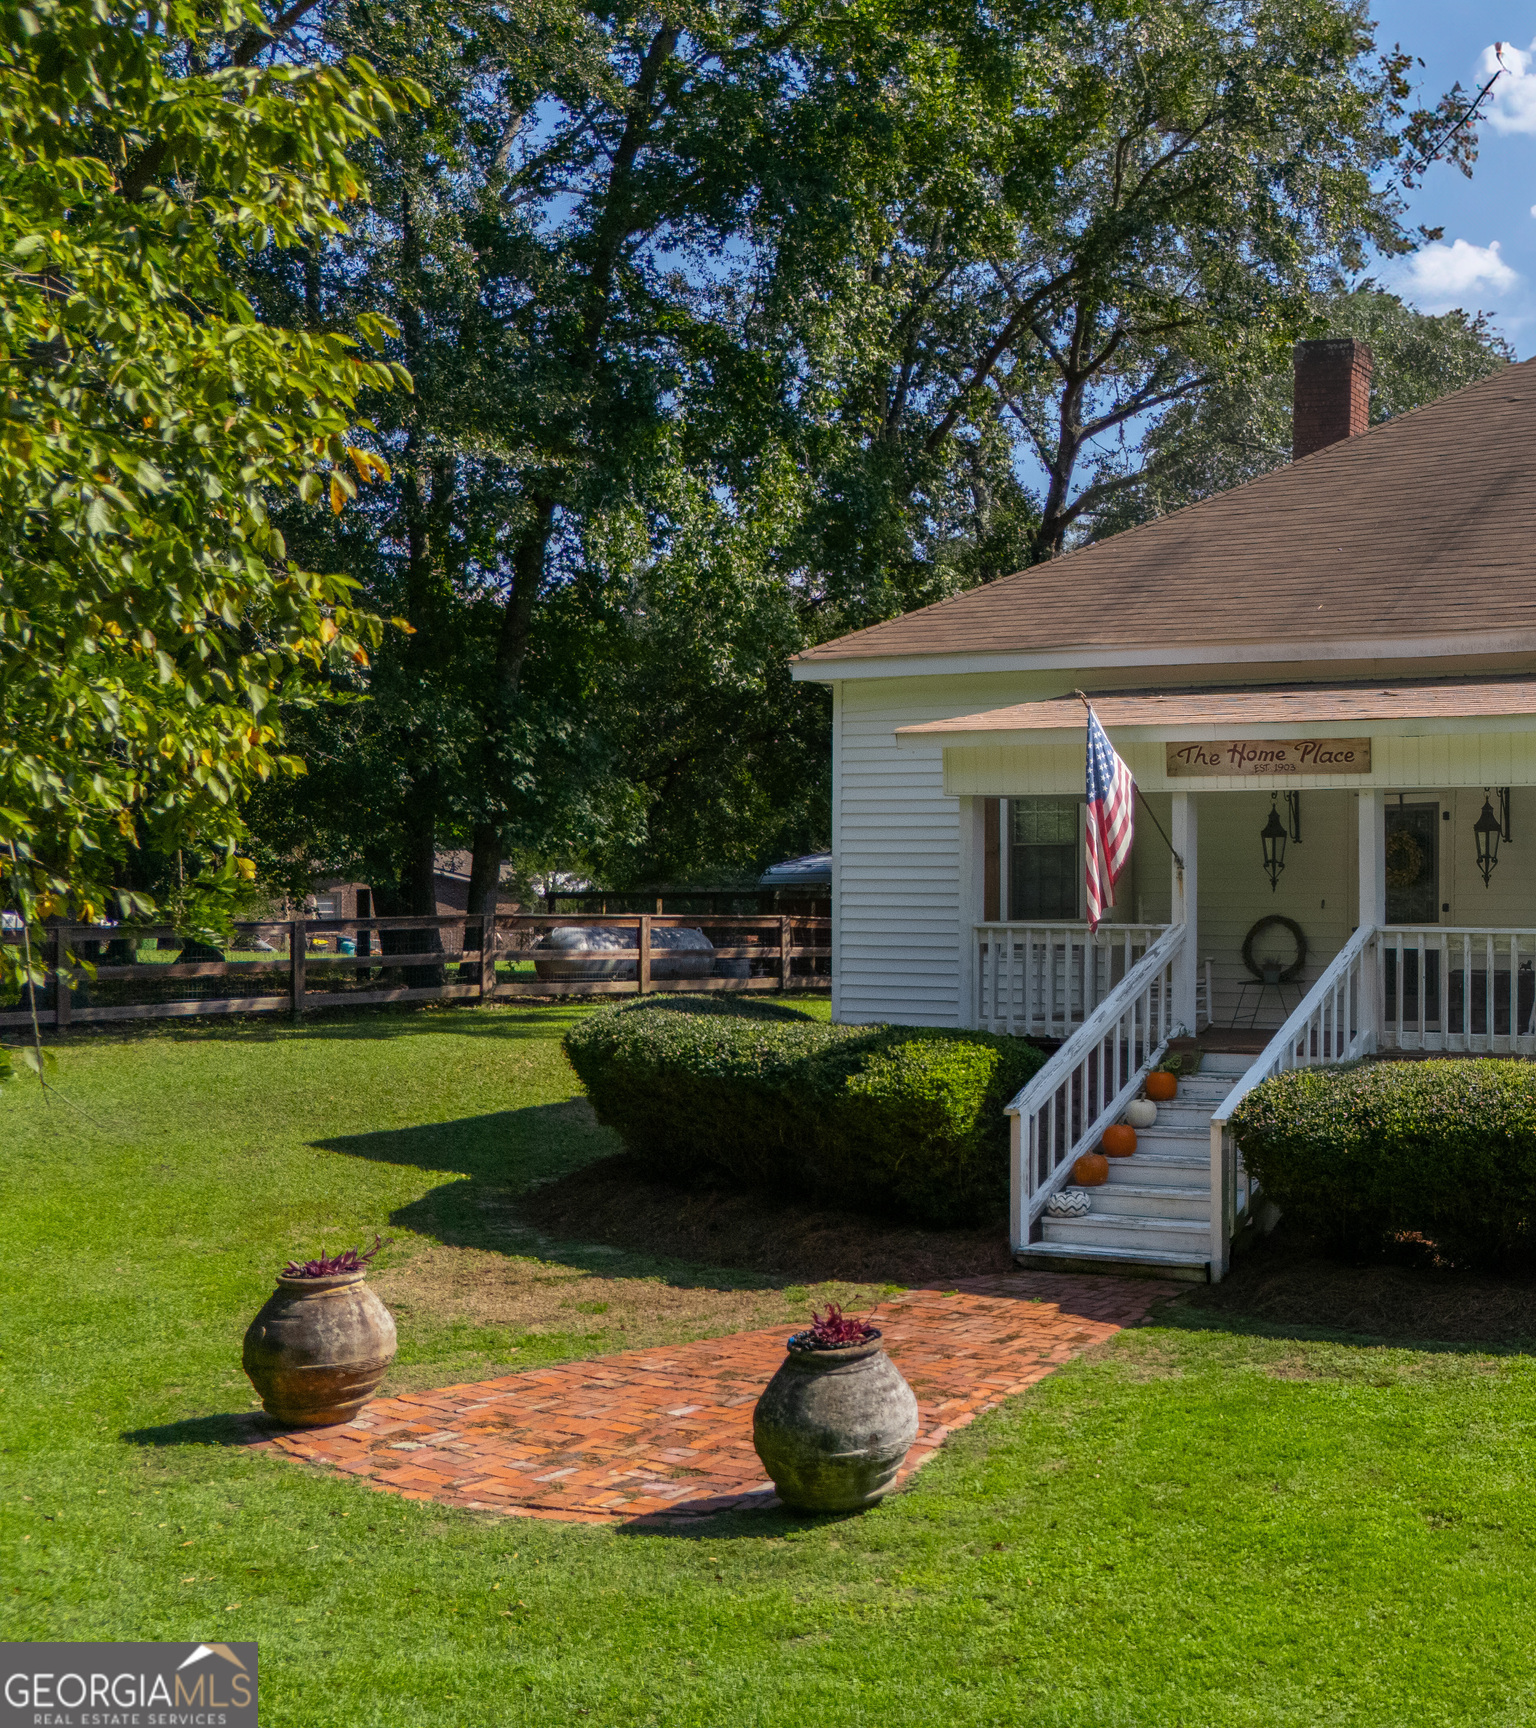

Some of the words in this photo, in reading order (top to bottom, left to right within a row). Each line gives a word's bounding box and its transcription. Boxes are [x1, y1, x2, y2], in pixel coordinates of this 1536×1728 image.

[1177, 745, 1221, 766] The
[1227, 743, 1286, 769] Home
[1294, 741, 1355, 764] Place
[1274, 763, 1296, 772] 1903
